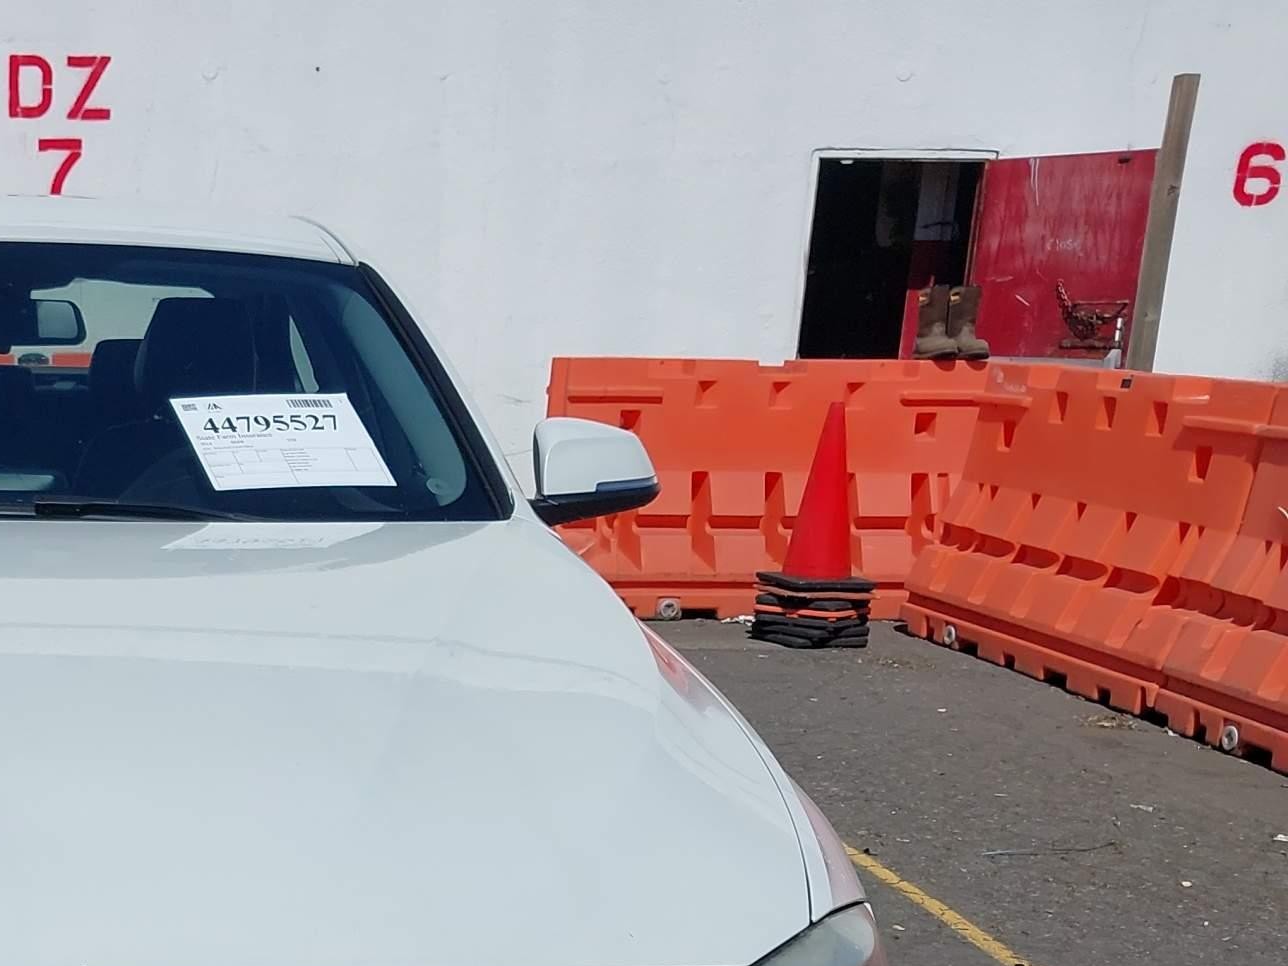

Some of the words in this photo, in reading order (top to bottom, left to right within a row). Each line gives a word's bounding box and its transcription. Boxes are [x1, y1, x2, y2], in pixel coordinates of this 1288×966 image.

[9, 55, 112, 120] DZ
[38, 138, 82, 195] 7
[1233, 142, 1286, 206] 6
[203, 414, 337, 434] 44795527
